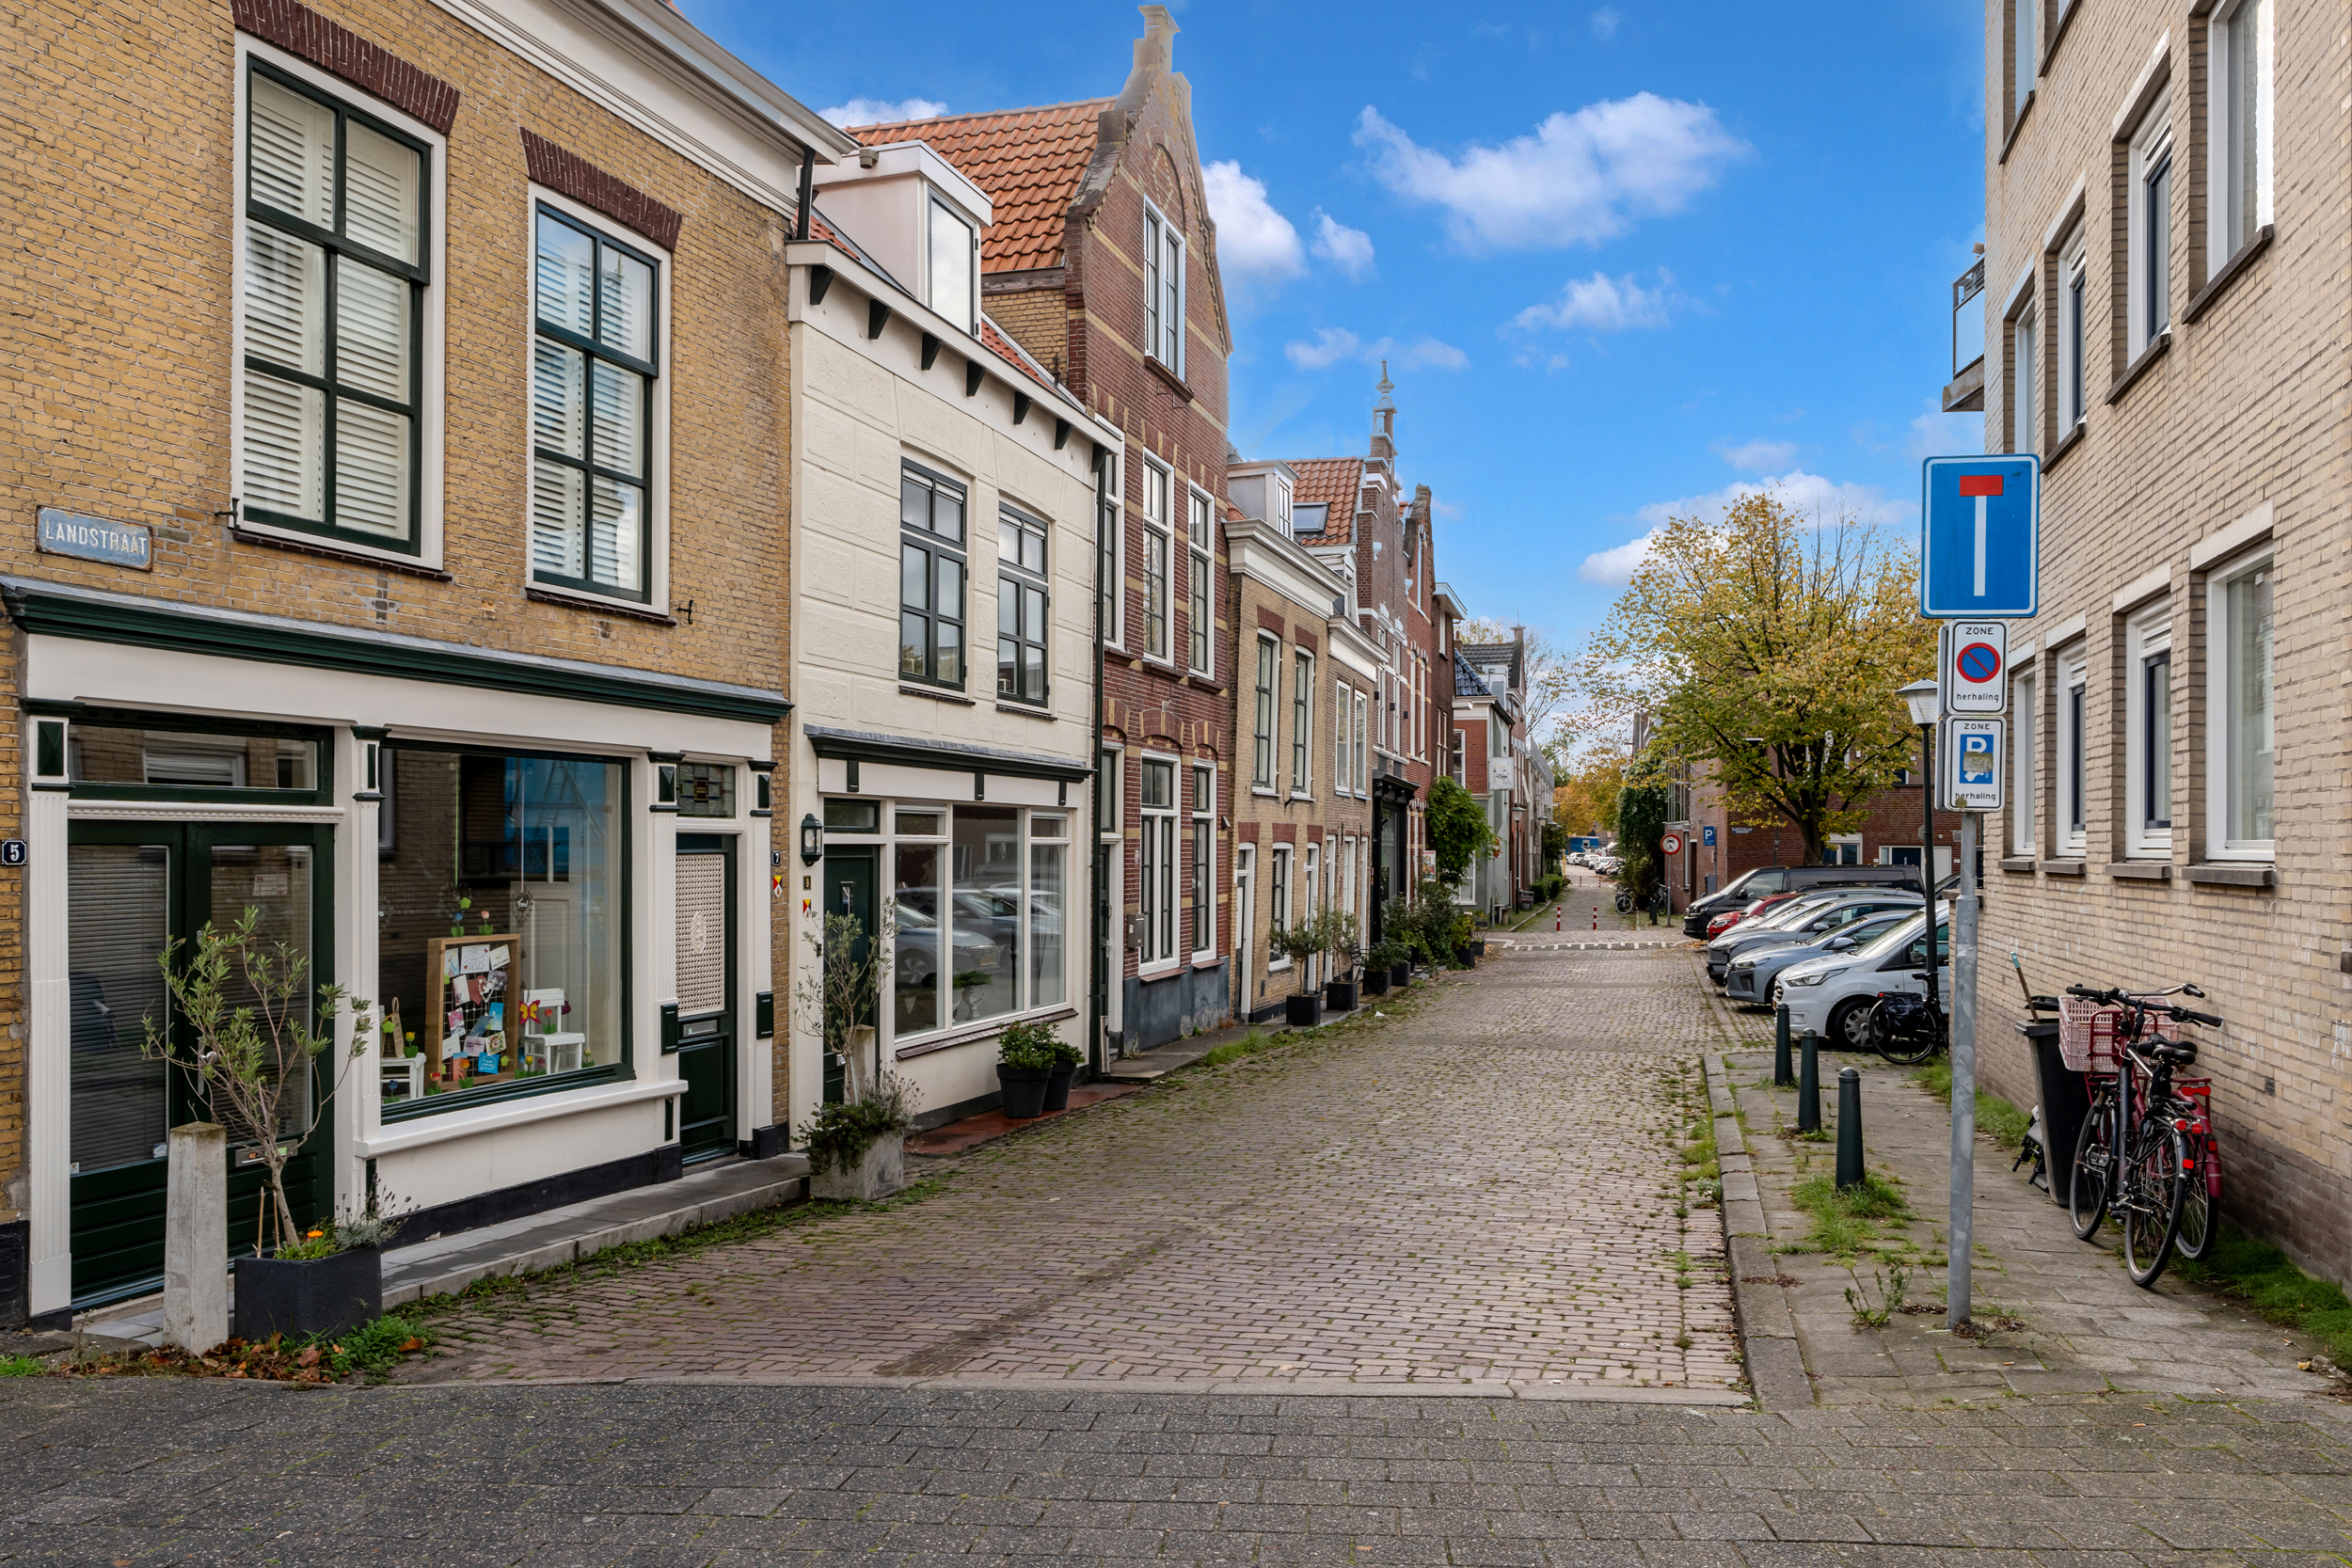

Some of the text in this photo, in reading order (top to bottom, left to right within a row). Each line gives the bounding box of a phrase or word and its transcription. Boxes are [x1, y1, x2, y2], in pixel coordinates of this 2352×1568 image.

[45, 519, 147, 556] LANDSTRAAT
[1965, 626, 1994, 635] ZONE
[1956, 693, 1999, 703] herhaling
[1955, 792, 1996, 800] herhaling
[1705, 829, 1713, 840] P
[9, 844, 20, 862] 5
[775, 852, 780, 863] 7
